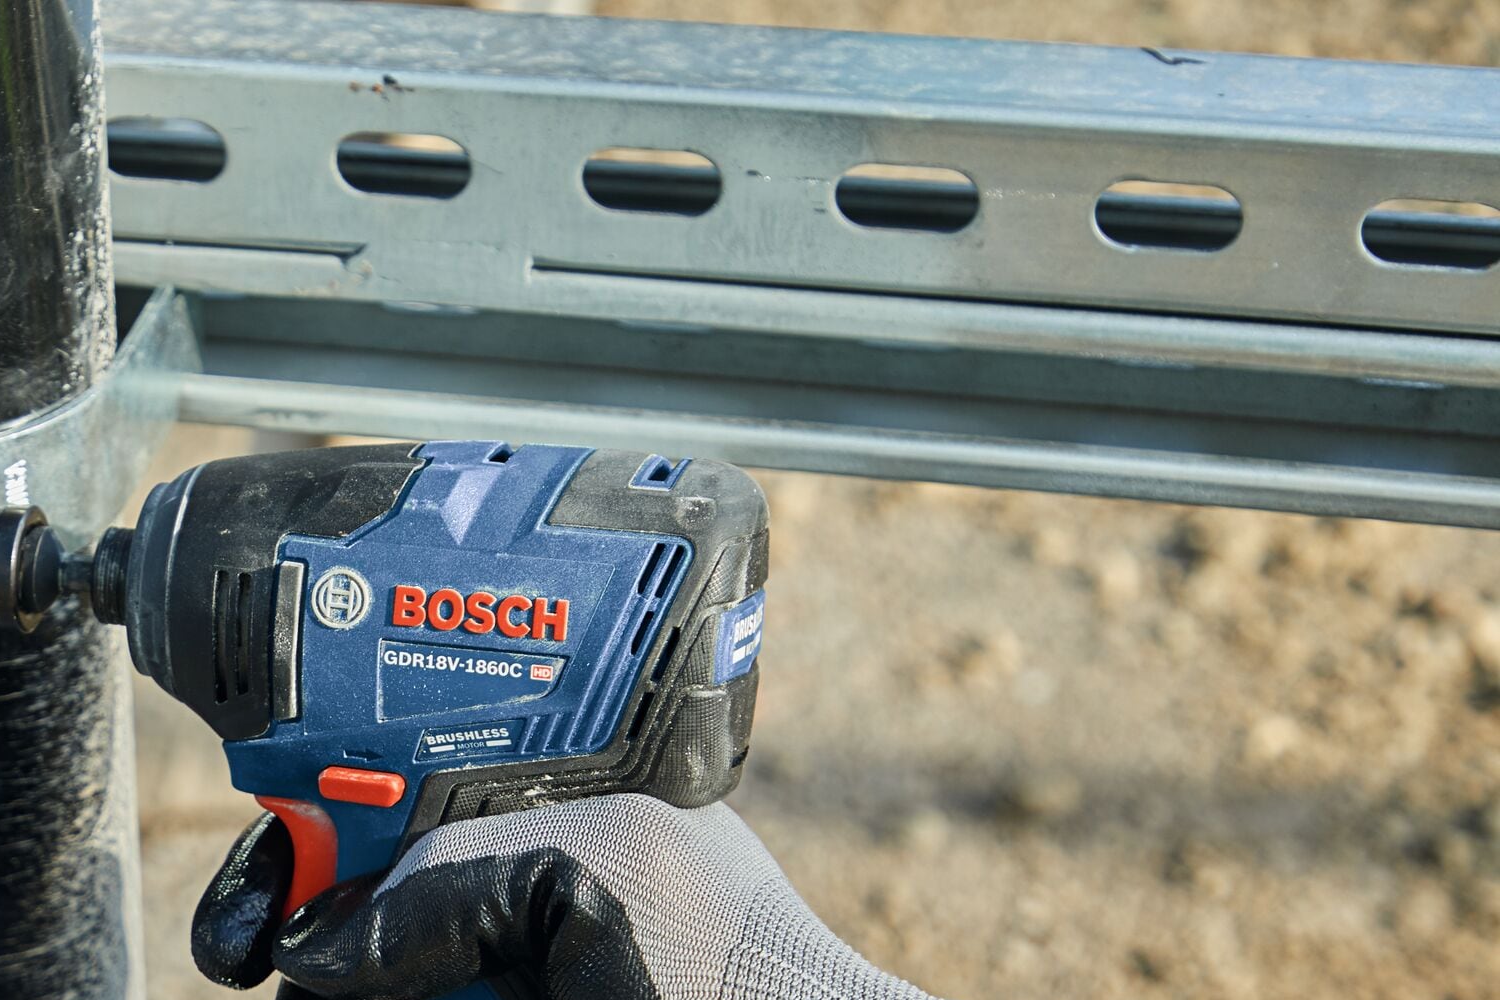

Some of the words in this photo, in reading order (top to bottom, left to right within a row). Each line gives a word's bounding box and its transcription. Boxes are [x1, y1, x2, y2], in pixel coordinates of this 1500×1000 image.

[392, 585, 570, 642] BOSCH
[383, 649, 524, 679] GDR18V-1860C
[532, 667, 551, 679] HD
[426, 727, 509, 745] BRUSHLESS
[457, 741, 485, 750] MOTOR
